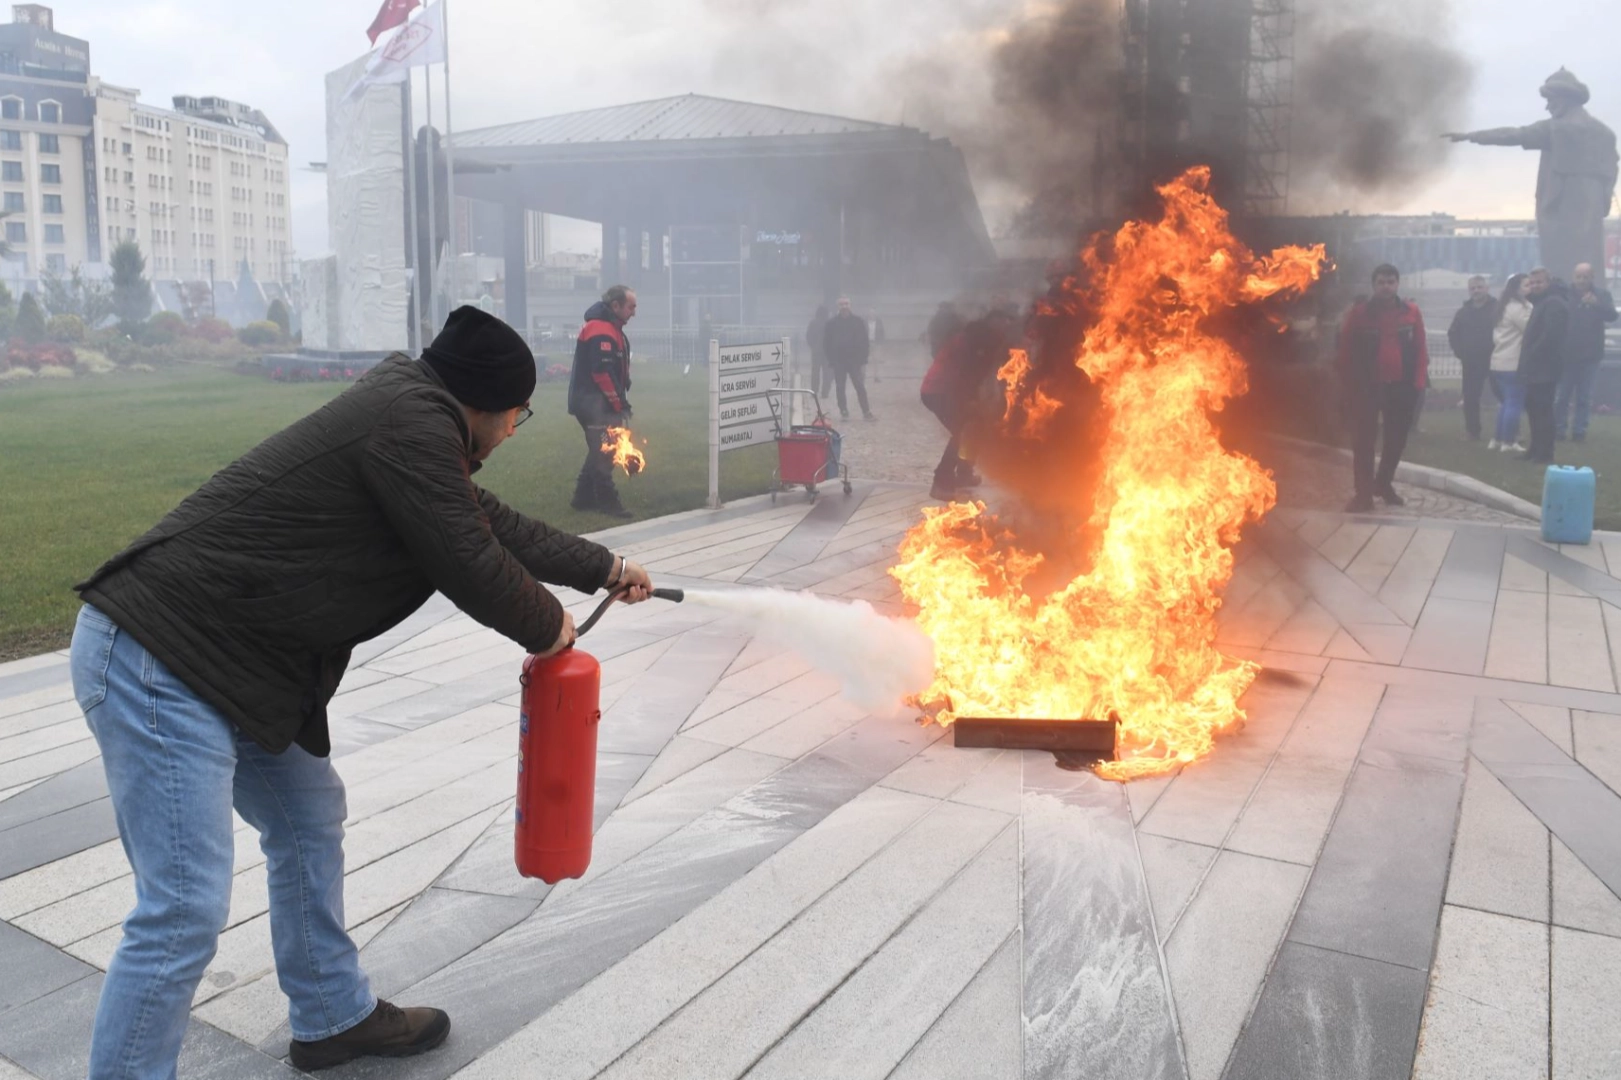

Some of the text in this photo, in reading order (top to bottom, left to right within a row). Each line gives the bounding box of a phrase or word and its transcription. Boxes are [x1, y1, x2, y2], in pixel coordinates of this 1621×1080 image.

[721, 350, 762, 364] EMLAK SERVİSİ
[721, 378, 757, 393] İCRA SERVİSİ
[721, 403, 758, 420] GELİR ŞEFLİĞİ
[721, 431, 753, 445] NUMARATAJ
